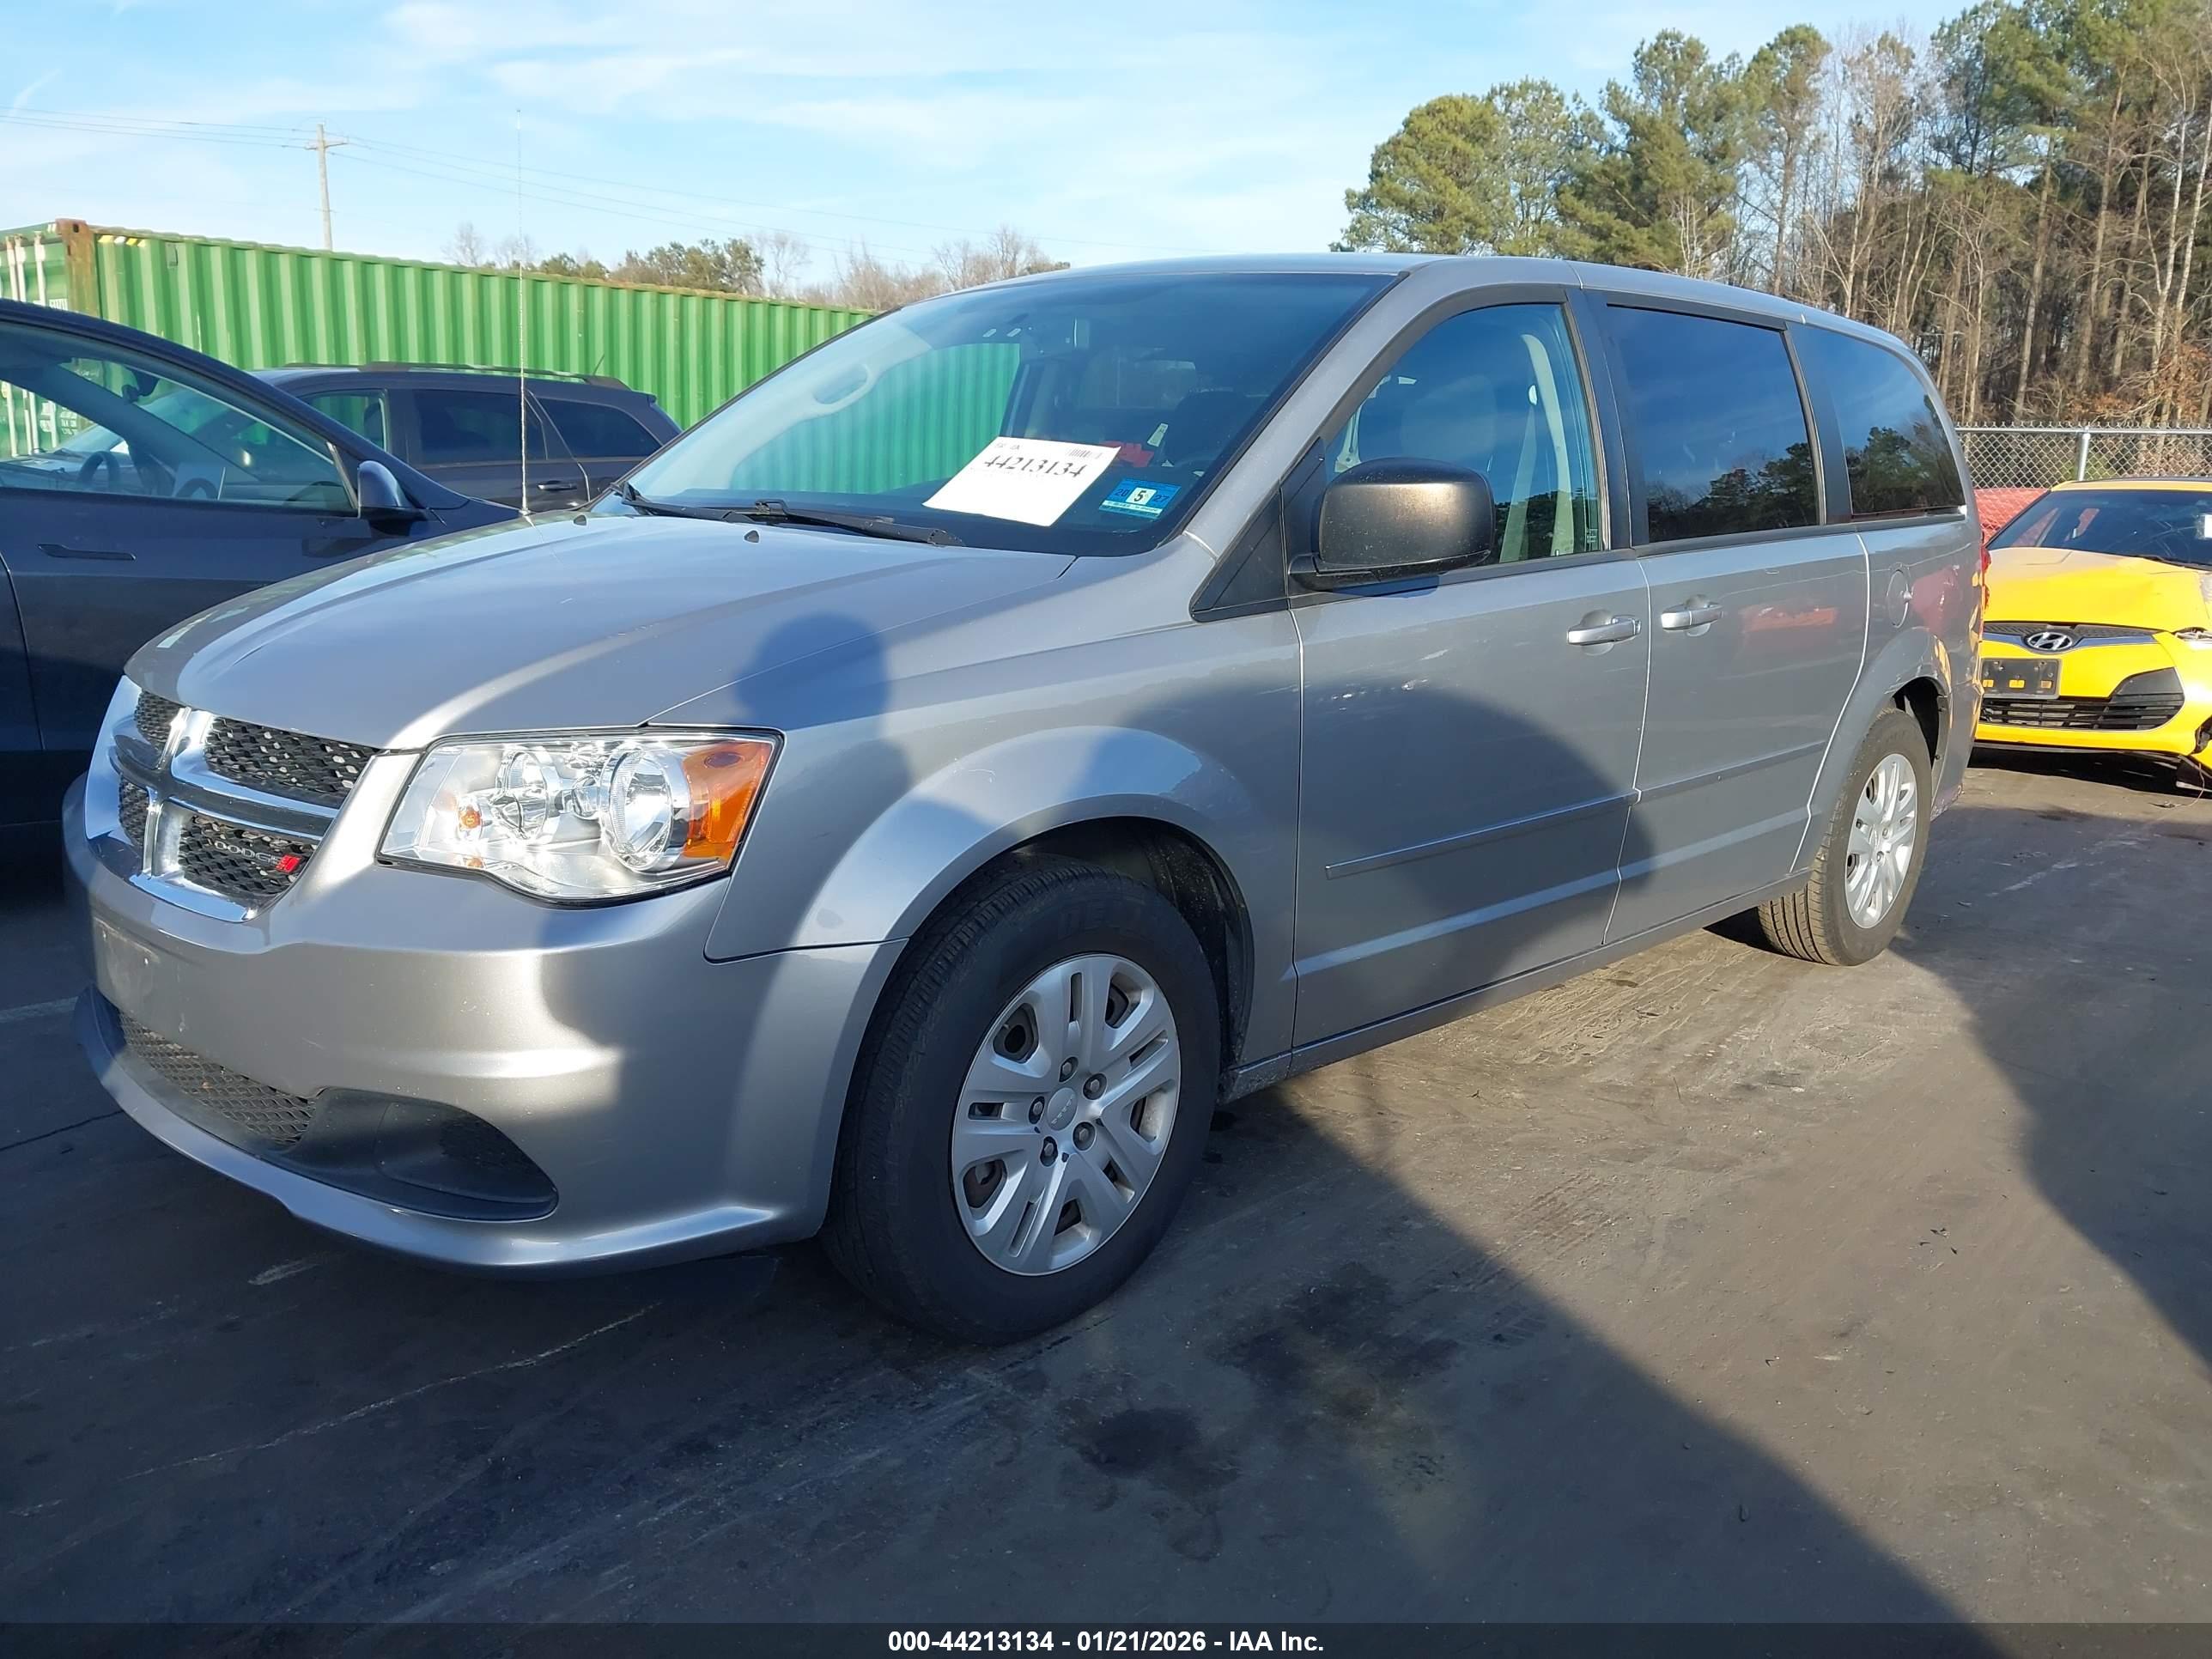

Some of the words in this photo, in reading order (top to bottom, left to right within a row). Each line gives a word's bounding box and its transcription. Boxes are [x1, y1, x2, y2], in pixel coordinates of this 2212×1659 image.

[984, 455, 1088, 477] 44213134
[1115, 488, 1130, 497] 20
[1133, 489, 1146, 502] 5
[214, 840, 280, 866] DODGE
